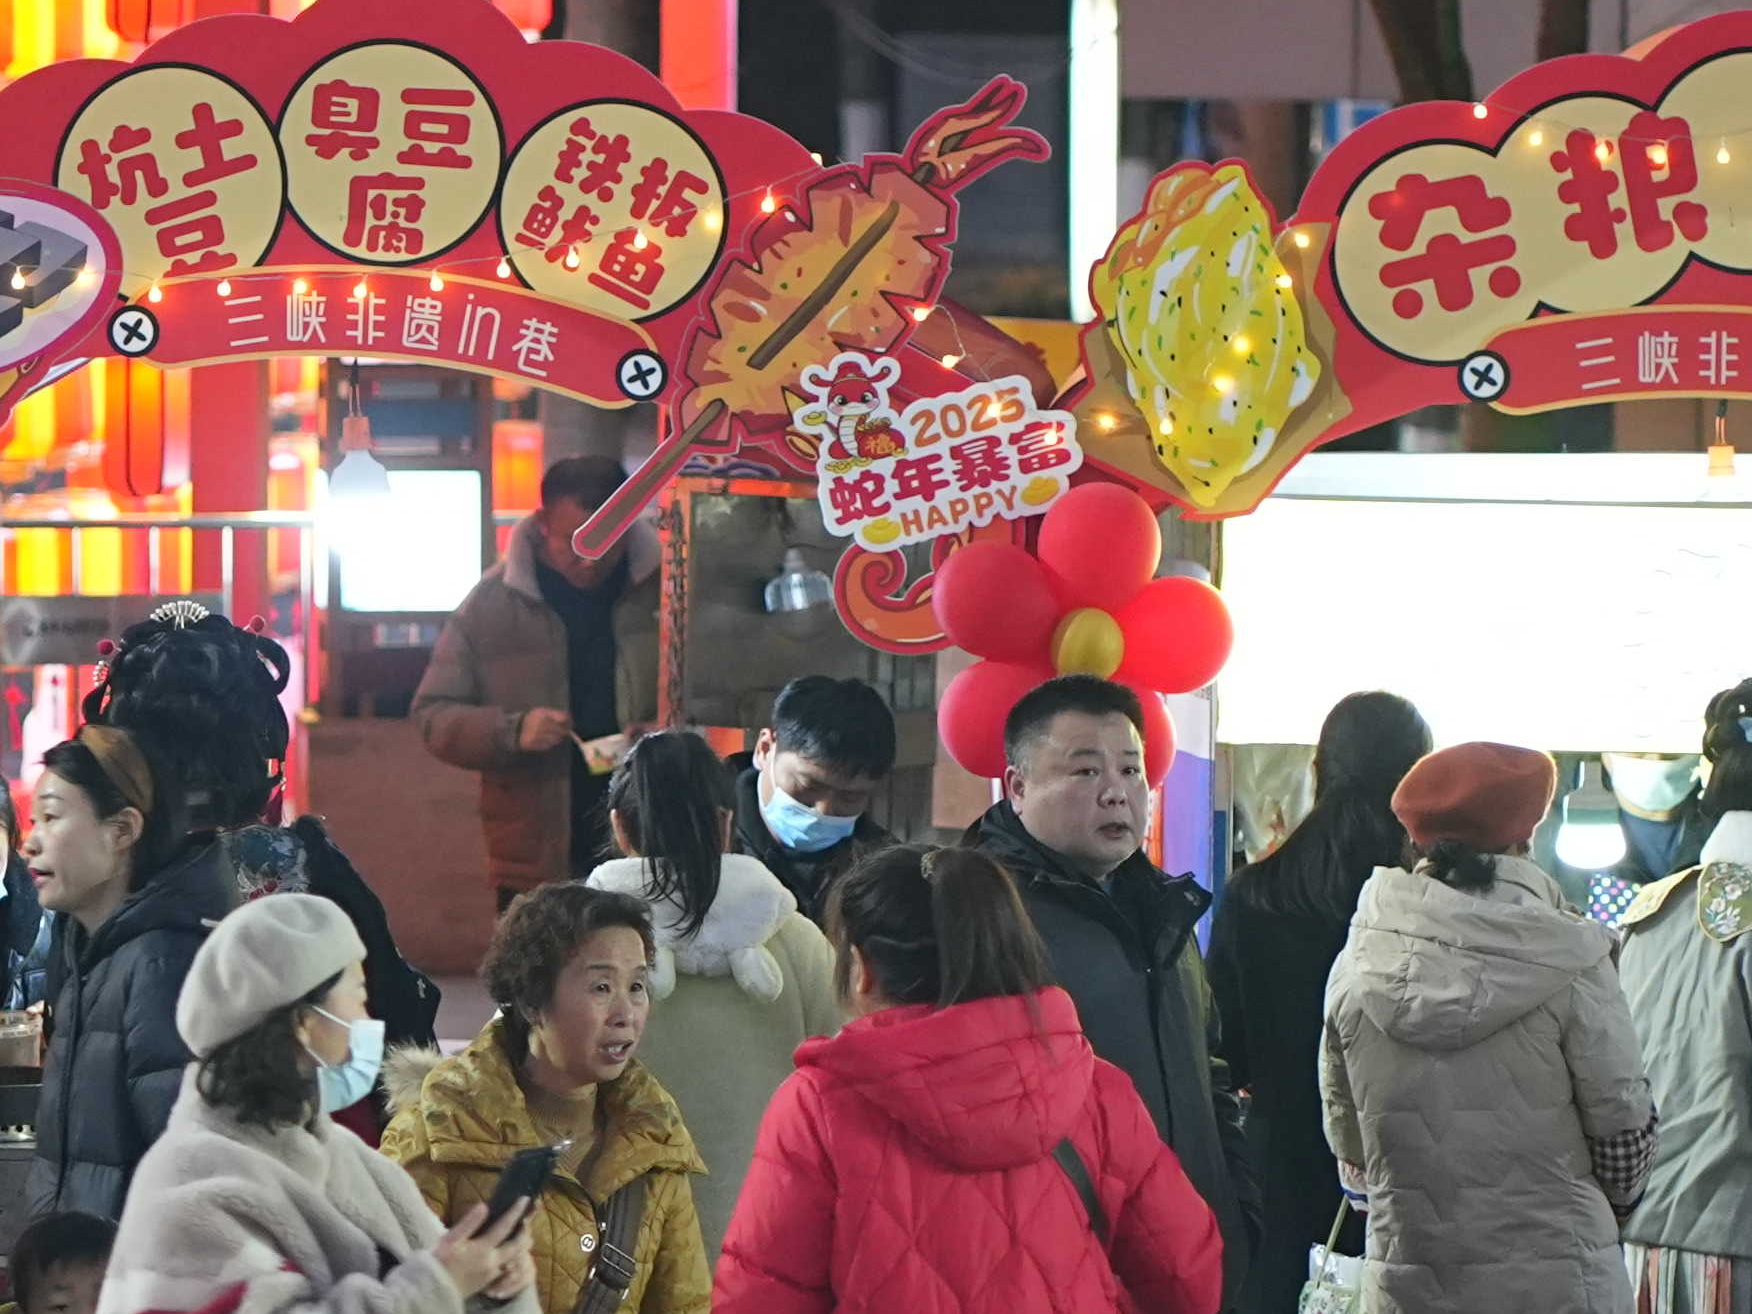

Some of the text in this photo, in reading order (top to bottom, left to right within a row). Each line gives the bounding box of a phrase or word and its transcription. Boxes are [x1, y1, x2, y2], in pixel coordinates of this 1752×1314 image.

[305, 79, 475, 169] 臭豆
[343, 172, 426, 255] 腐
[554, 117, 709, 238] 铁板
[144, 189, 238, 278] 豆
[515, 185, 665, 311] 鱿鱼
[909, 386, 1026, 449] 2025
[827, 420, 1072, 526] 蛇年暴富
[899, 485, 1019, 538] HAPPY
